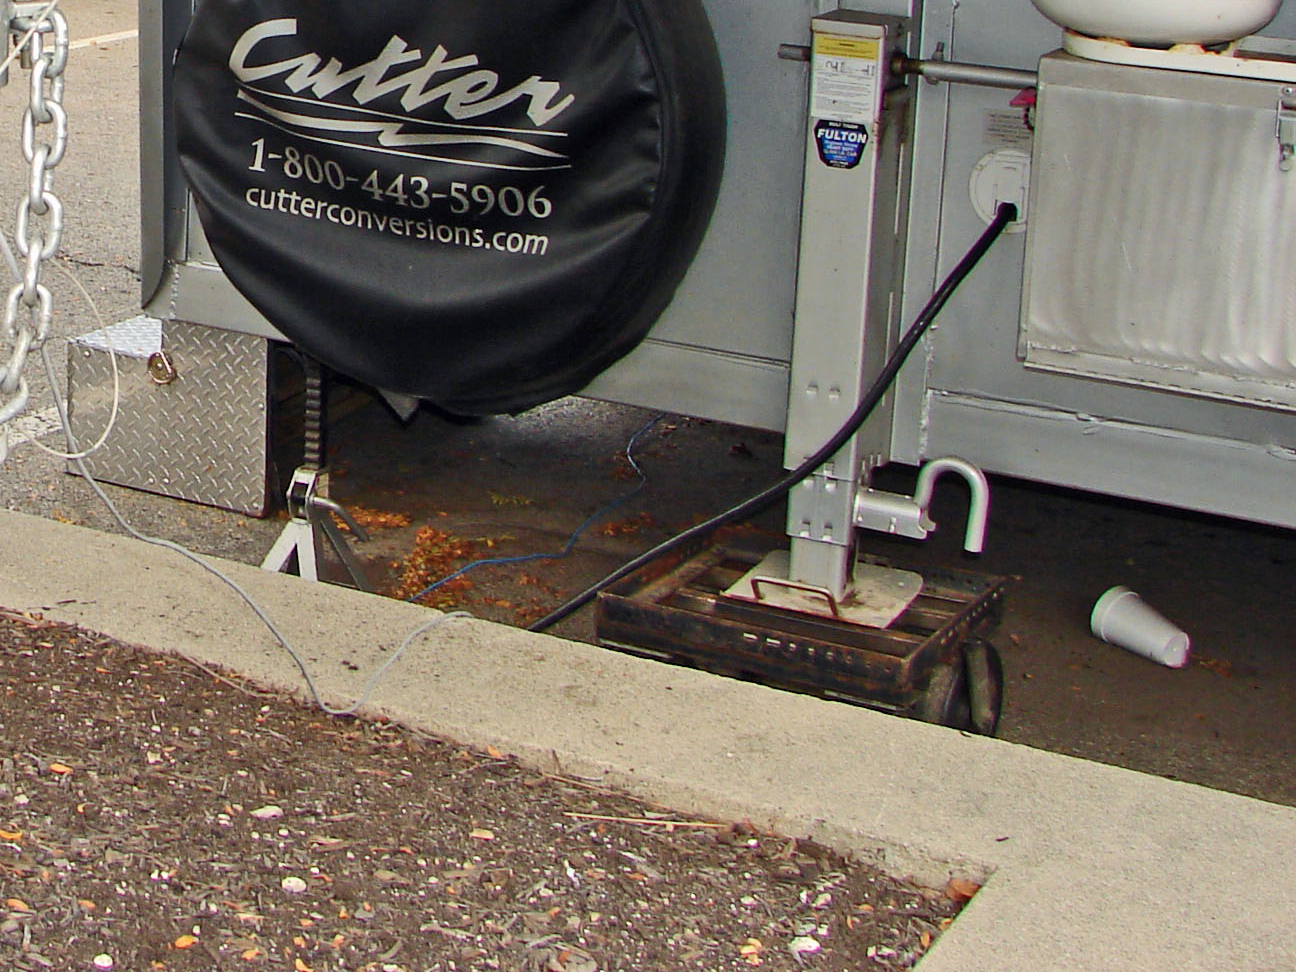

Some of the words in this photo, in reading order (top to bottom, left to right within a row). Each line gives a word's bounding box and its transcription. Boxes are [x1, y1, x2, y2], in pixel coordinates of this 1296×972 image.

[228, 18, 575, 127] Cutter
[817, 128, 867, 144] FULTON
[247, 137, 553, 220] 1-800-443-5906
[245, 186, 549, 256] cutterconversions.com
